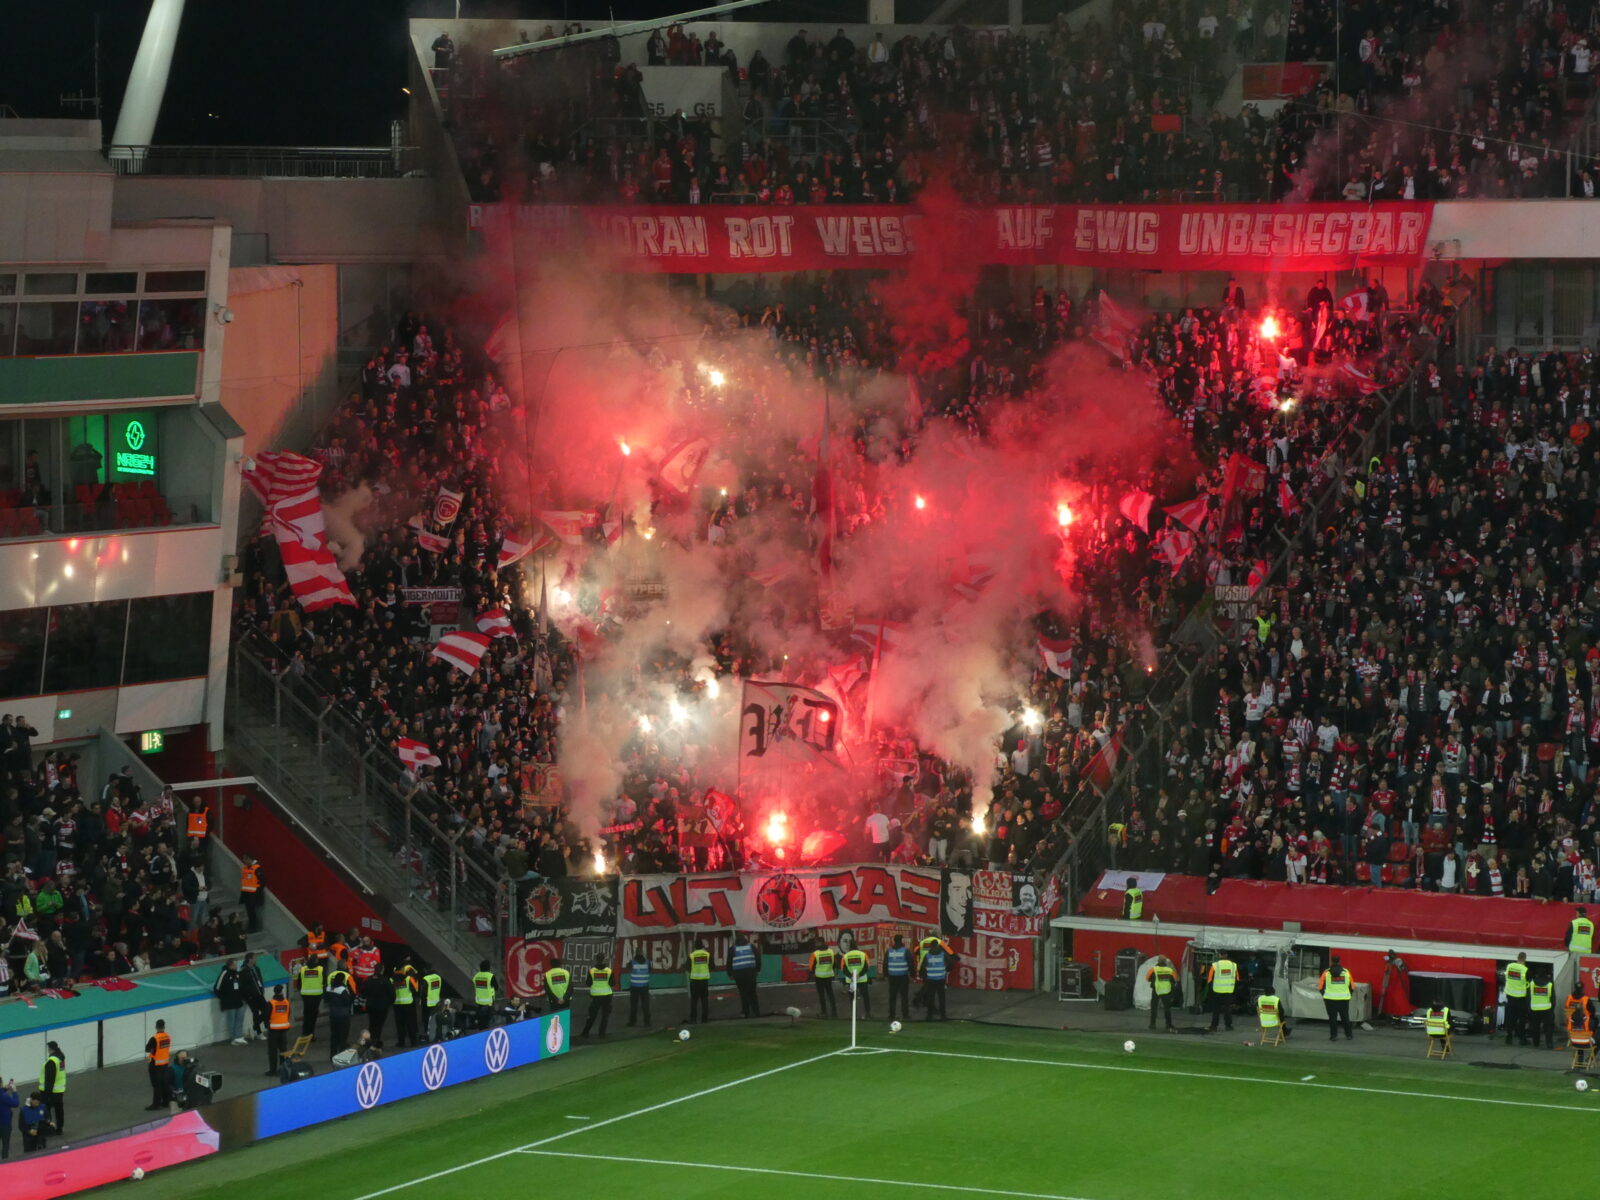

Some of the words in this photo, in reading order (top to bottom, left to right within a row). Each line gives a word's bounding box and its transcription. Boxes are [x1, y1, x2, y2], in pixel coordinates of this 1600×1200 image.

[693, 102, 715, 116] G5
[724, 214, 794, 258] ROT
[996, 208, 1055, 250] AUF
[1075, 209, 1159, 255] EWIG
[1179, 211, 1424, 257] UNBESIEGBAR
